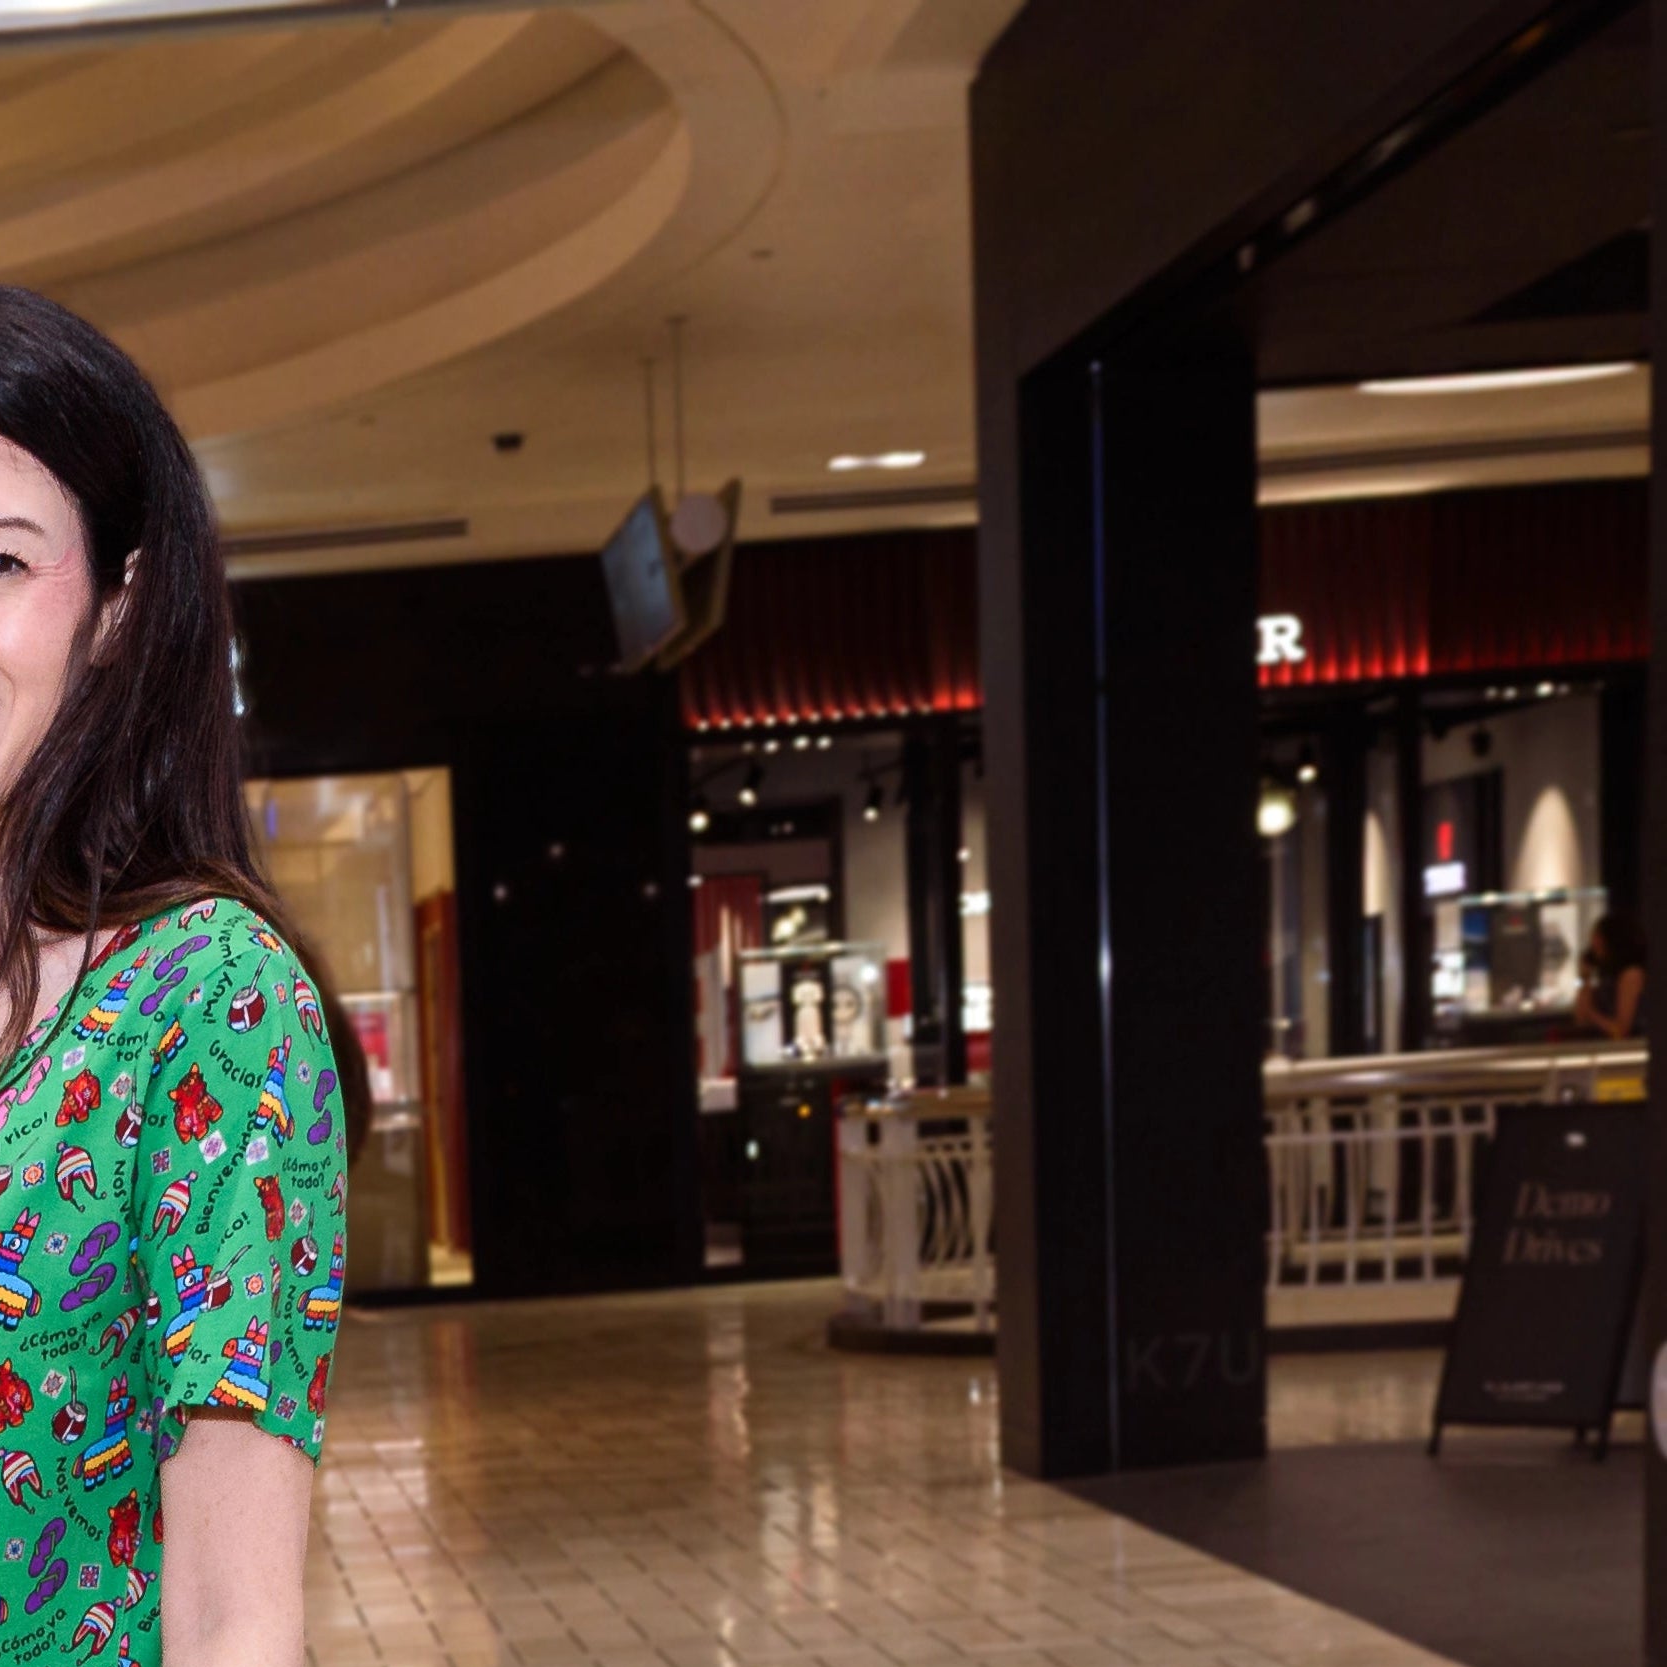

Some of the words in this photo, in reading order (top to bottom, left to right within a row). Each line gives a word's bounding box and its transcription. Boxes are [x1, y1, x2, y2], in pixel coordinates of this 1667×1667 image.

[1257, 615, 1304, 664] R
[209, 1039, 263, 1088] Gracias
[4, 1112, 48, 1145] rico!
[20, 1328, 78, 1352] ¿Cómo
[82, 1311, 102, 1331] va
[41, 1334, 87, 1361] todo?
[56, 1456, 68, 1494] Nos
[63, 1497, 103, 1542] vemos
[47, 1608, 67, 1629] va
[13, 1633, 57, 1665] todo?
